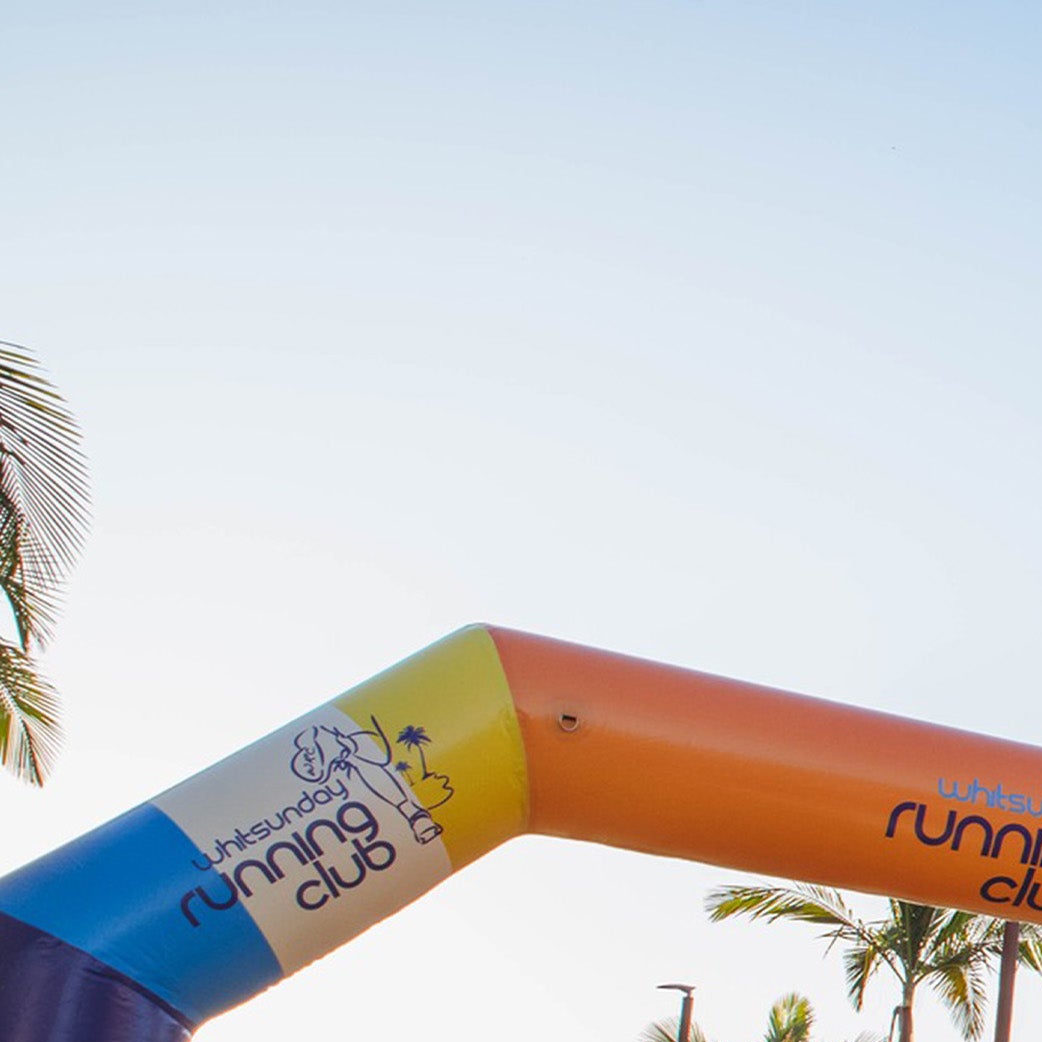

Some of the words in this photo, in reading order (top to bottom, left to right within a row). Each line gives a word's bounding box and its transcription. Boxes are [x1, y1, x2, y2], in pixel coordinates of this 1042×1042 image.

[180, 801, 379, 928] running
[191, 778, 349, 872] whitsunday
[295, 837, 397, 911] club
